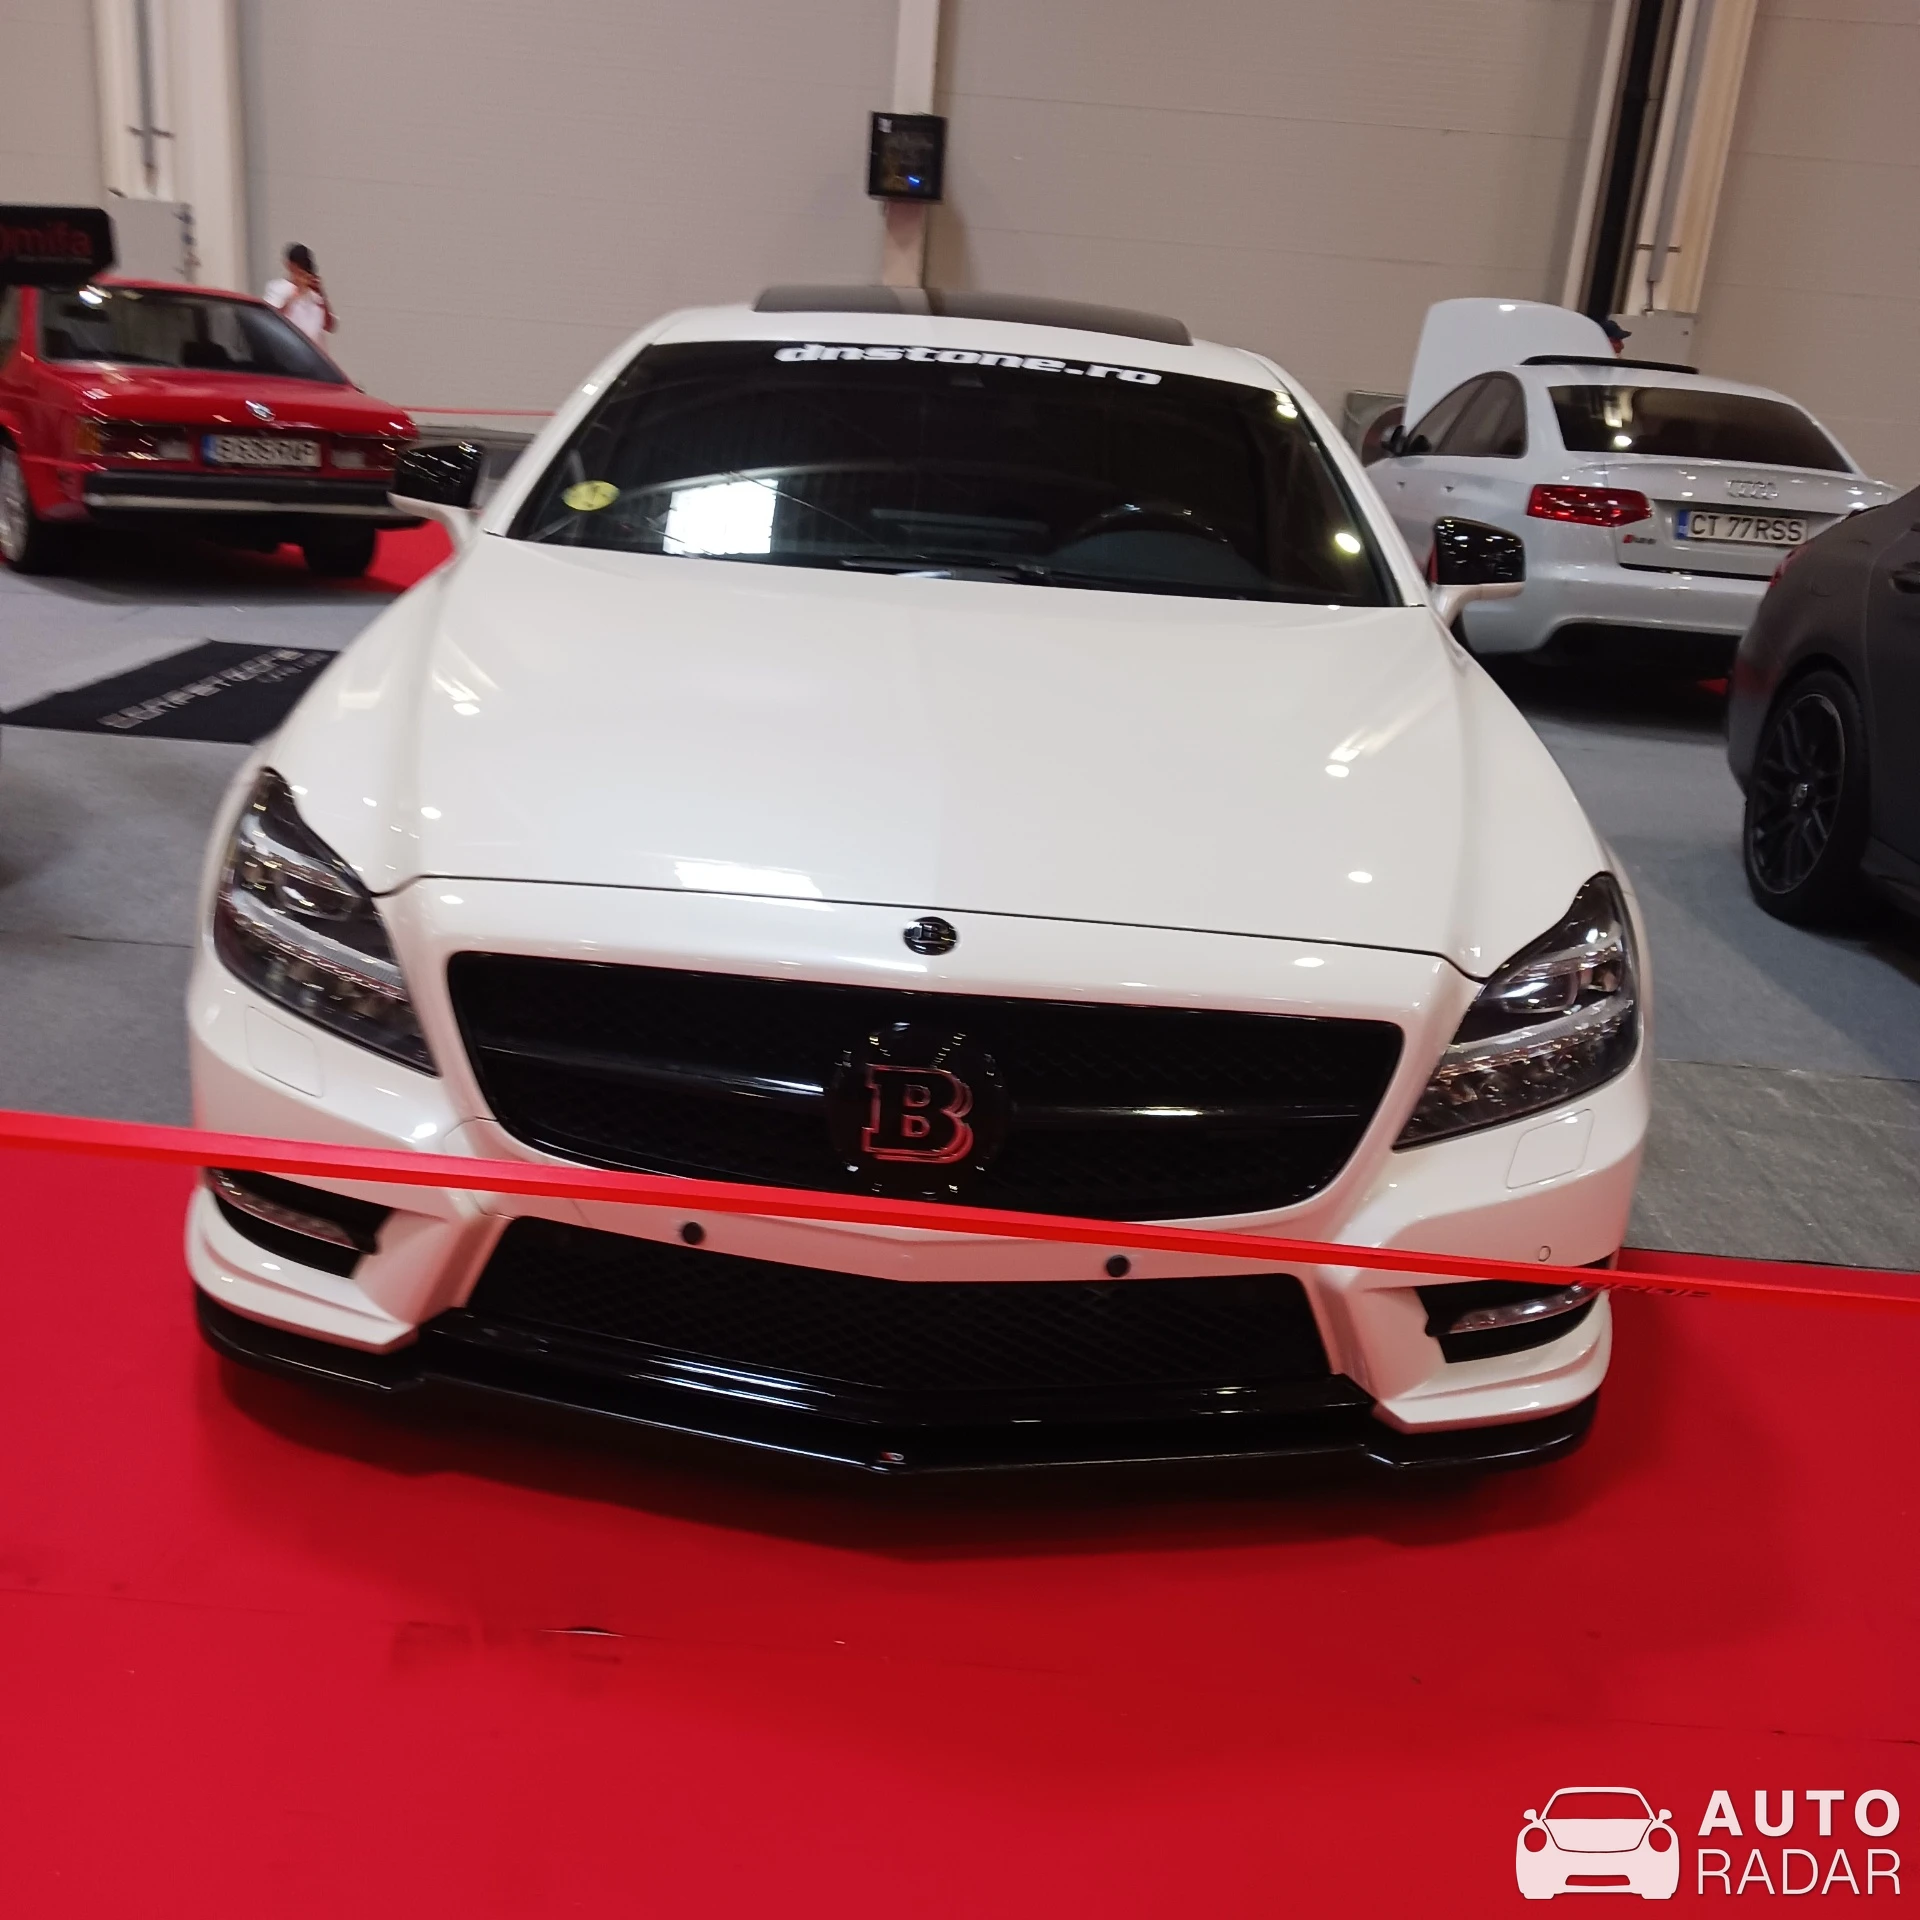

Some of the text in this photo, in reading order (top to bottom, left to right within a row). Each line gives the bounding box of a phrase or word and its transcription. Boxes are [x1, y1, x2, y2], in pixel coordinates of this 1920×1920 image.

[774, 344, 1162, 385] dnstone.ro
[1690, 514, 1801, 542] CT 77RSS
[862, 1063, 973, 1164] B
